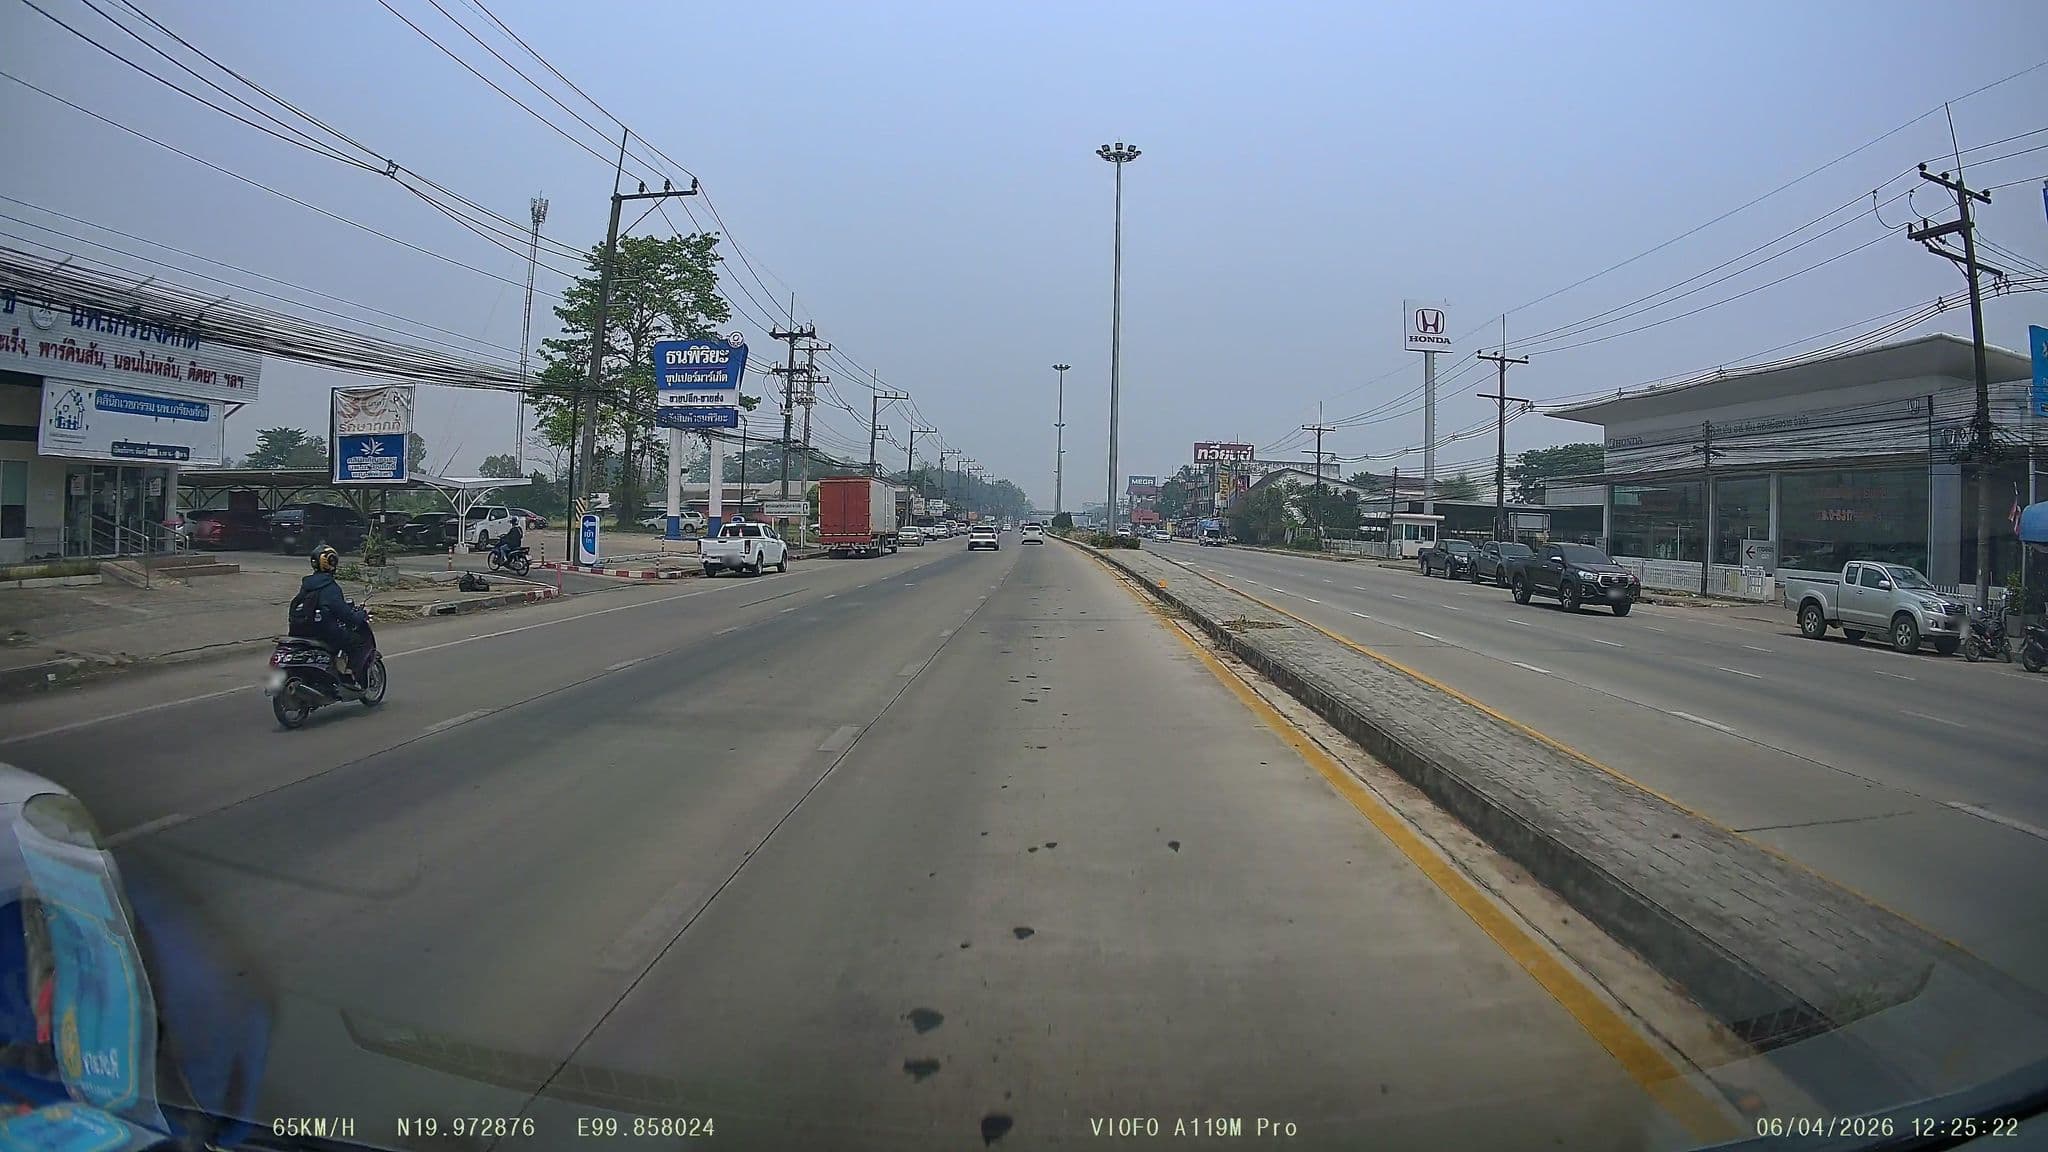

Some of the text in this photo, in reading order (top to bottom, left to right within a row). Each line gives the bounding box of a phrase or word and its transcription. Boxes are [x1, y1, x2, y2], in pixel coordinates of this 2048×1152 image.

[1409, 335, 1452, 344] HONDA
[665, 345, 730, 365] ธนพิริยะ
